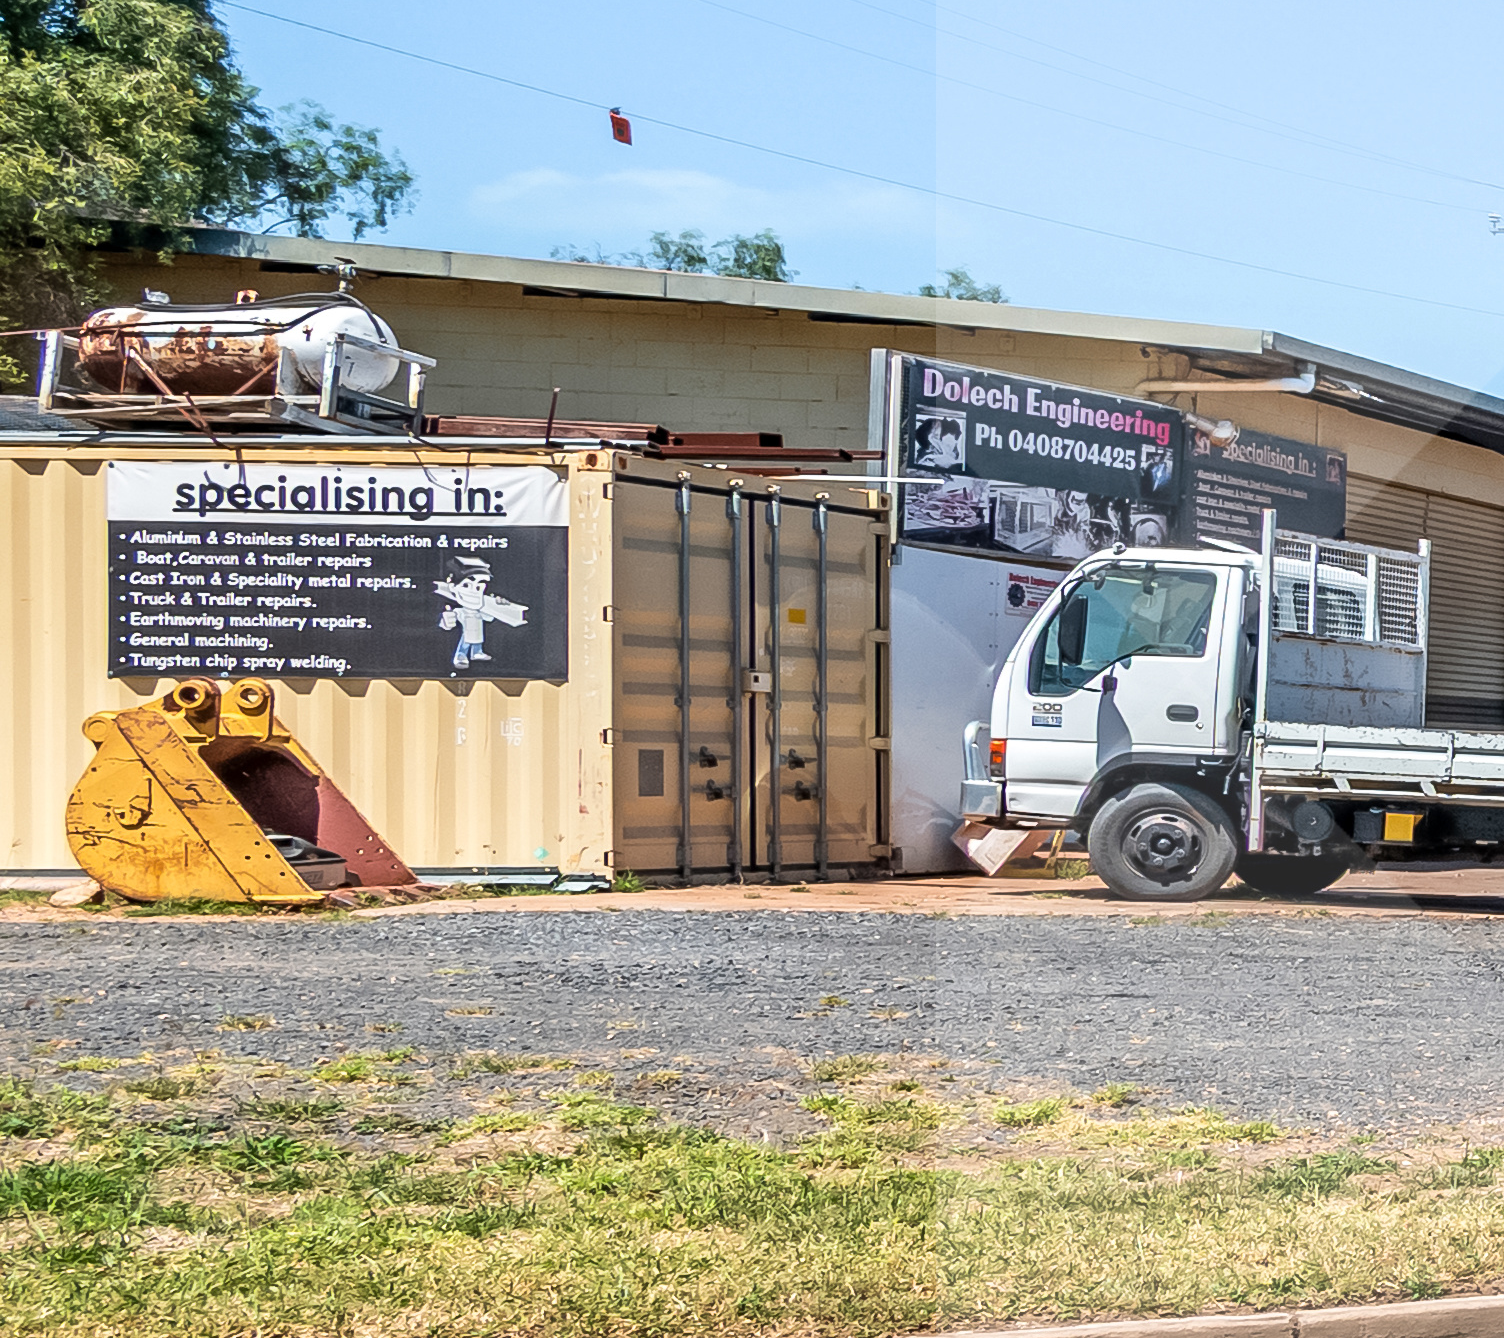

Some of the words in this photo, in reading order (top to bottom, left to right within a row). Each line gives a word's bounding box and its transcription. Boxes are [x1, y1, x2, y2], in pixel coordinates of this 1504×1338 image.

[923, 368, 1019, 413] Dolech
[1026, 387, 1170, 446] Engineering
[975, 422, 1003, 449] Ph
[1008, 429, 1136, 470] 0408704425
[176, 474, 434, 521] specialising
[454, 477, 504, 513] in:
[130, 530, 201, 545] Aluminium
[206, 531, 219, 545] &
[223, 532, 293, 546] Stainless
[299, 533, 340, 547] Steel
[345, 533, 431, 548] Fabrication
[437, 535, 449, 548] &
[454, 536, 508, 551] repairs
[245, 552, 256, 566] &
[262, 553, 312, 566] trailer
[318, 554, 372, 570] repairs
[129, 571, 165, 585] Cast
[170, 572, 205, 585] Iron
[210, 572, 222, 585] &
[227, 573, 303, 590] Speciality
[308, 574, 351, 587] metal
[357, 575, 416, 591] repairs.
[129, 592, 175, 605] Truck
[180, 592, 193, 605] &
[197, 592, 252, 606] Trailer
[256, 594, 317, 610] repairs.
[129, 612, 224, 629] Earthmoving
[229, 613, 307, 631] machinery
[312, 615, 372, 631] repairs.
[129, 633, 189, 647] General
[194, 634, 273, 650] machining.
[129, 653, 200, 670] Tungsten
[205, 654, 237, 669] chip
[242, 657, 285, 671] spray
[290, 655, 351, 671] welding.
